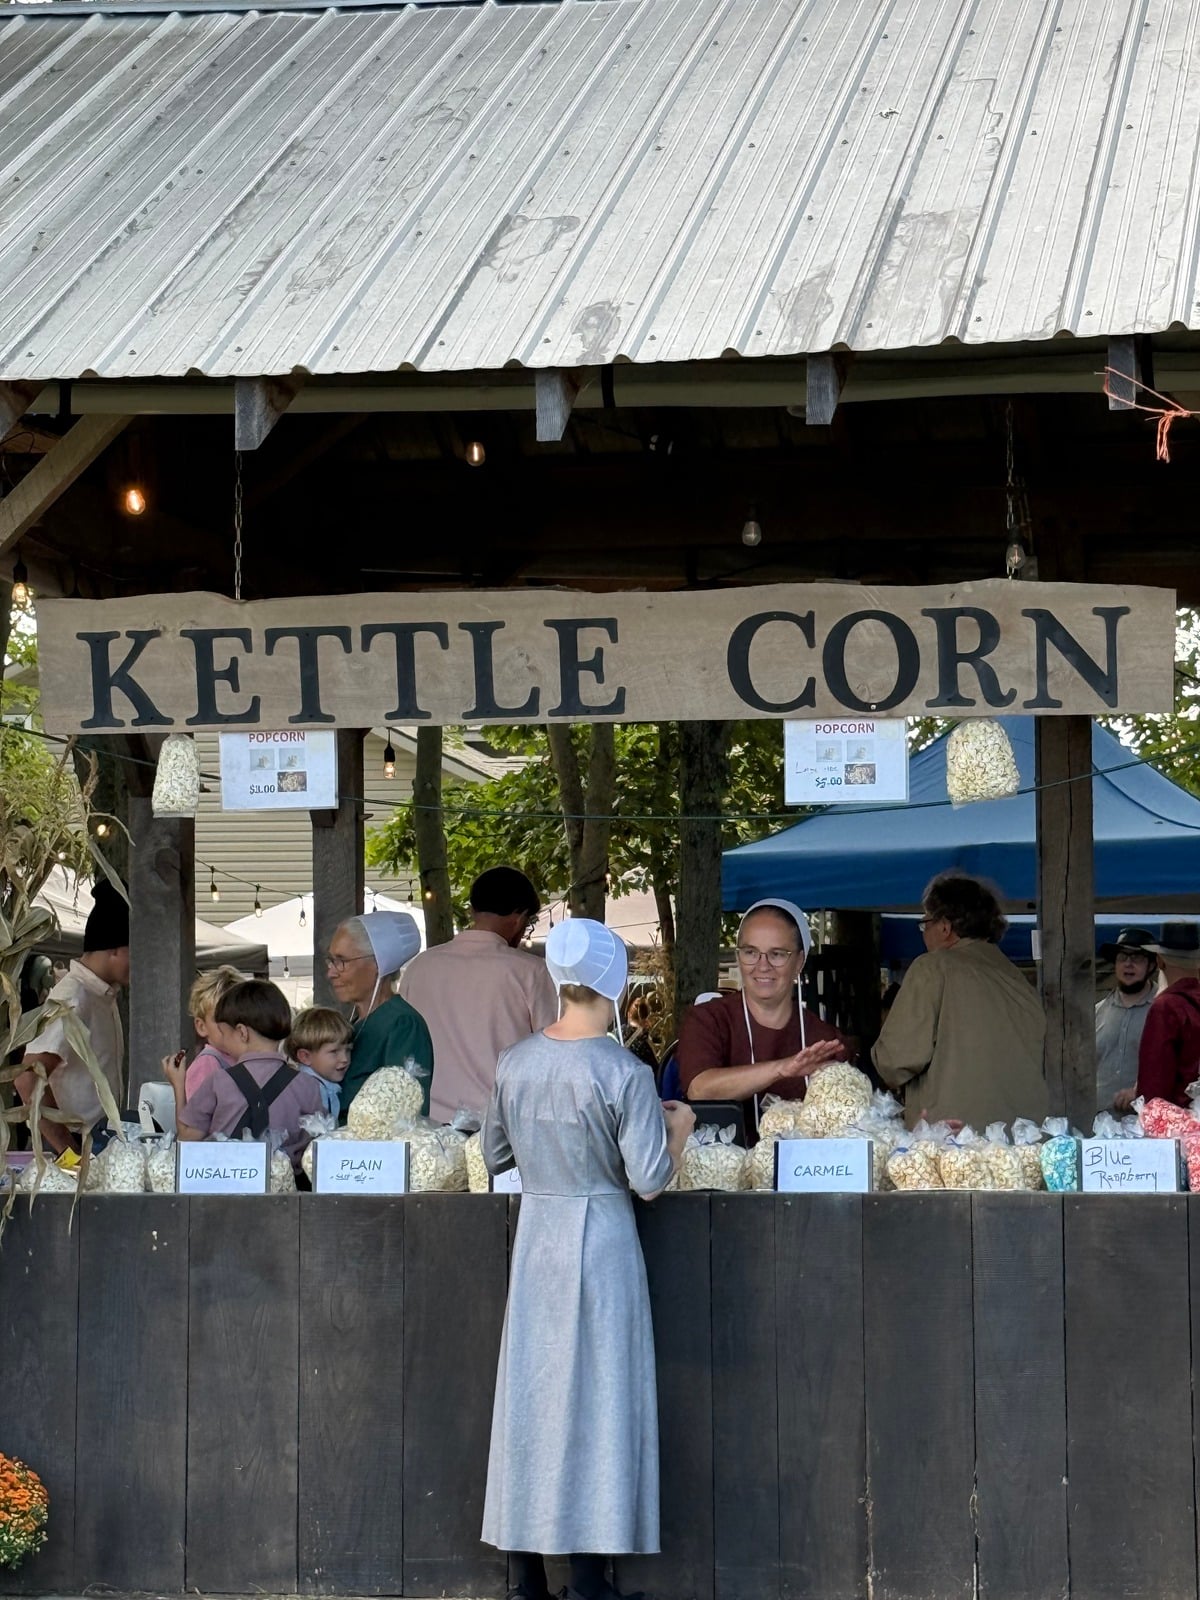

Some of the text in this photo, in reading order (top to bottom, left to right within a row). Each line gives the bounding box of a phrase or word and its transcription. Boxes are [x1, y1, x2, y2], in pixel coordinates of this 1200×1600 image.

[77, 606, 1131, 730] KETTLE CORN
[815, 723, 875, 733] POPCORN
[249, 731, 305, 742] POPCORN
[1085, 1144, 1132, 1167] Blue
[341, 1159, 383, 1171] PLAIN
[794, 1165, 854, 1177] CARMEL
[186, 1168, 258, 1180] UNSALTED
